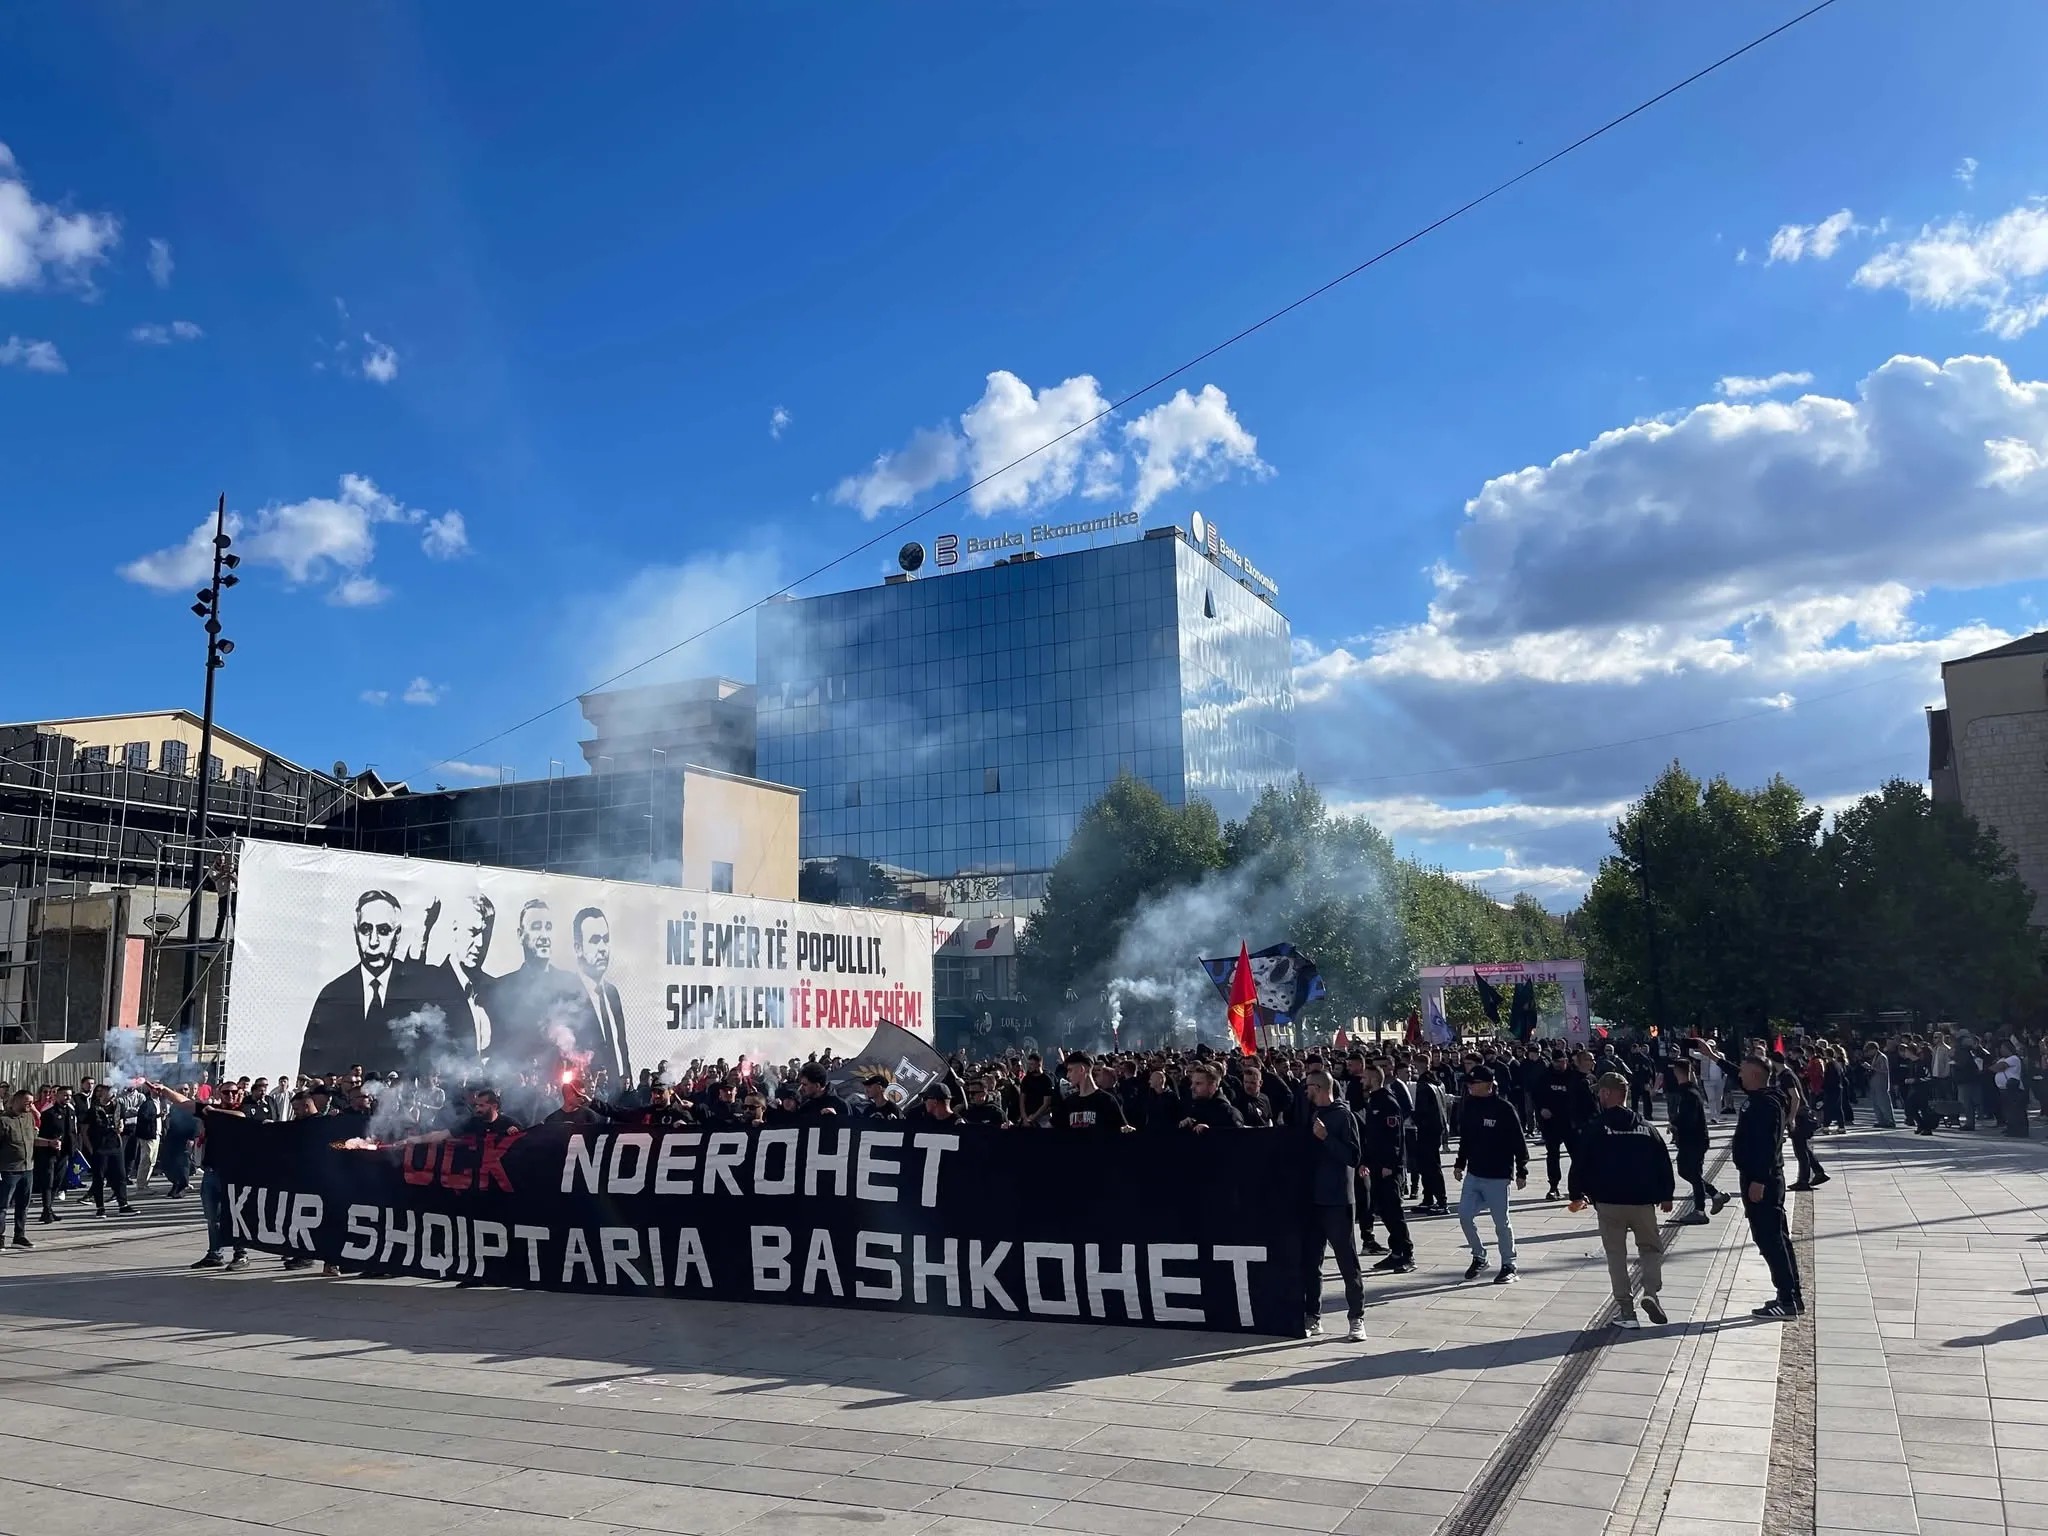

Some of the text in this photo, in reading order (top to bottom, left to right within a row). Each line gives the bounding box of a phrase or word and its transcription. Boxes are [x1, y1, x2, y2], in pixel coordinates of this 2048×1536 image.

[967, 510, 1139, 554] Banka Ekonomike
[1219, 537, 1279, 596] Banka Ekonomike
[666, 910, 887, 979] NË EMËR TË POPULLIT,
[666, 984, 785, 1030] SHPALLENI
[790, 978, 812, 1029] TË
[815, 982, 922, 1029] PAFAJSHËM!
[1505, 972, 1557, 984] FINISH
[560, 1127, 960, 1208] NDEROHET
[227, 1183, 1268, 1327] KUR SHQIPTARIA BASHKOHET
